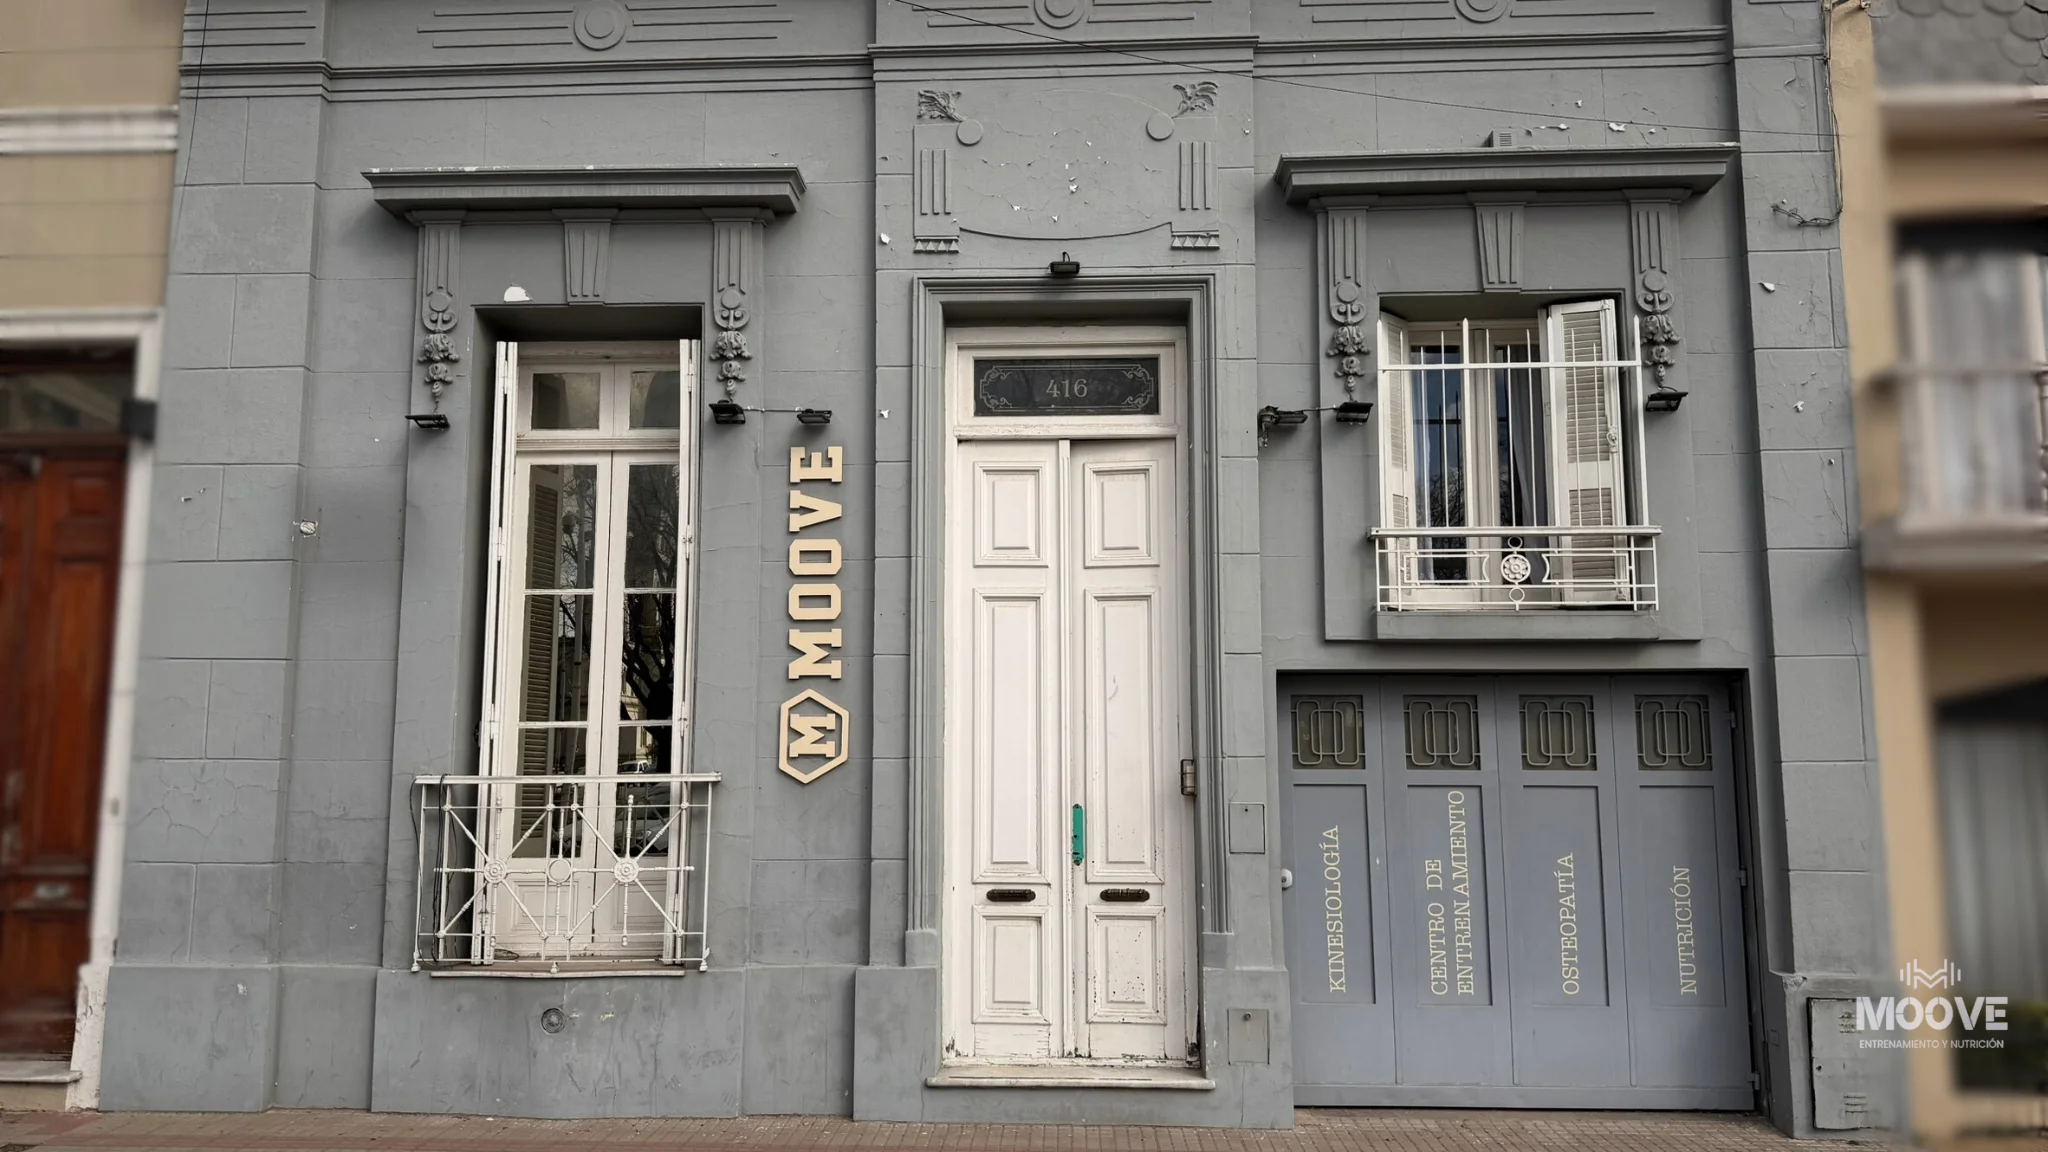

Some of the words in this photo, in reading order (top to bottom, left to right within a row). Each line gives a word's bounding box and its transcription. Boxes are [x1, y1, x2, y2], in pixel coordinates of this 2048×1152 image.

[1046, 378, 1088, 398] 416
[788, 446, 843, 680] MOOVE
[1320, 825, 1346, 993] KINESIOLOGÍA
[1425, 859, 1443, 891] DE
[1447, 790, 1475, 996] ENTRENAMIENTO
[1553, 852, 1580, 995] OSTEOPATÍA
[1670, 866, 1698, 995] NUTRICIÓN
[1429, 902, 1448, 995] CENTRO
